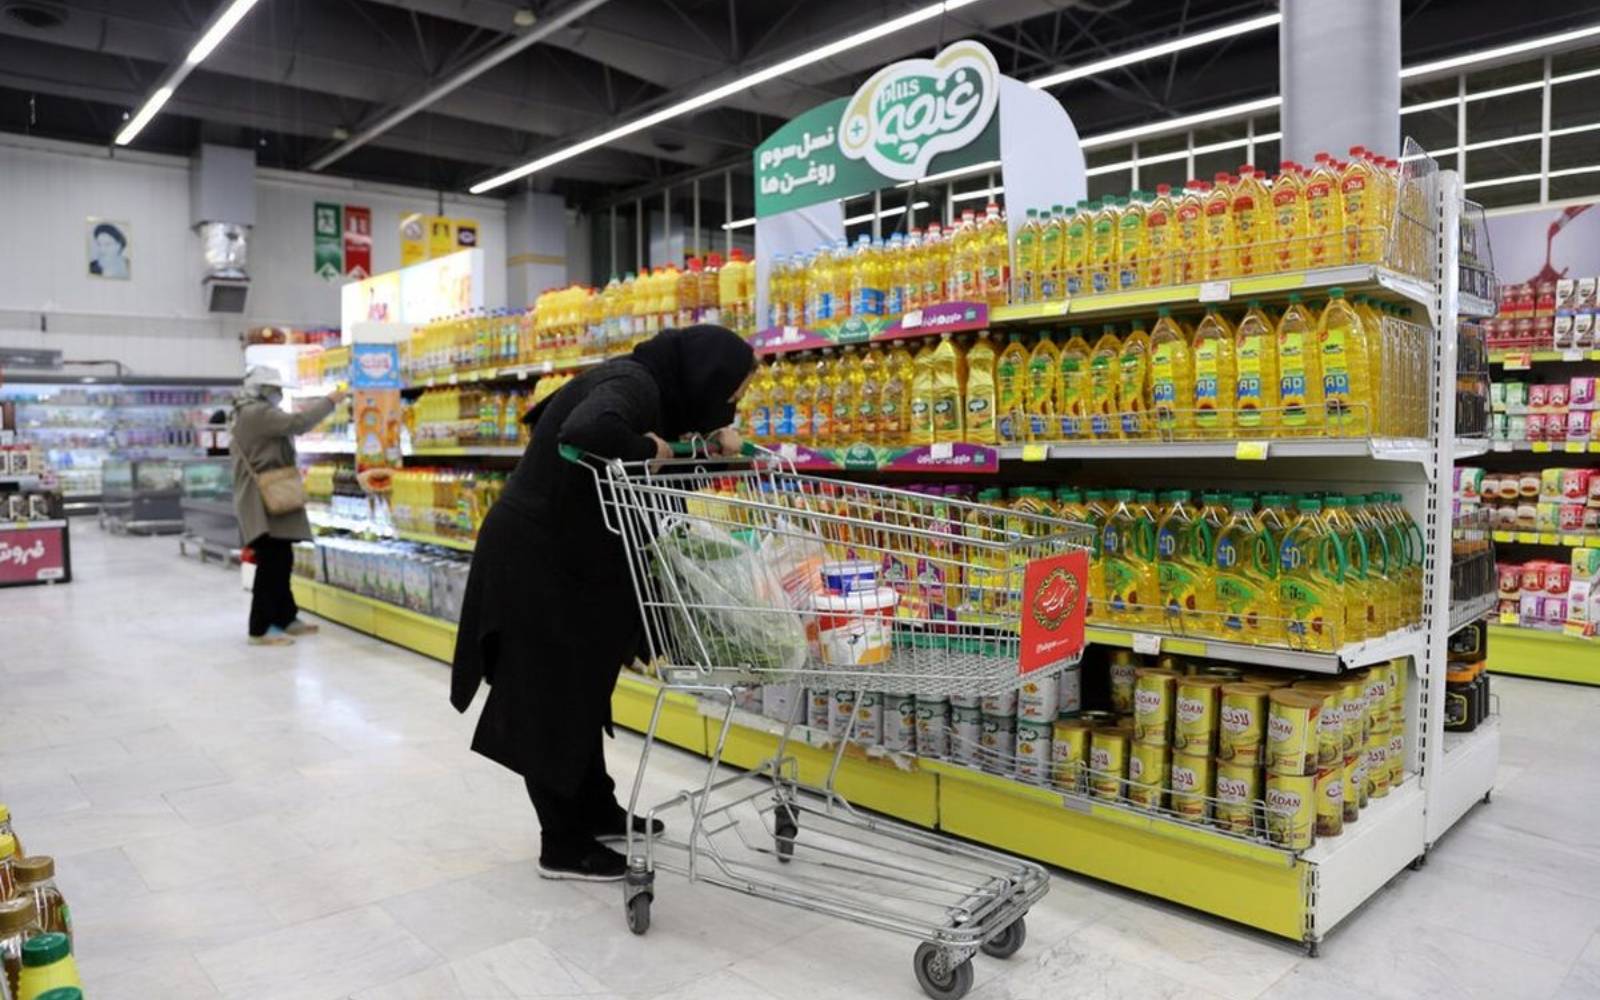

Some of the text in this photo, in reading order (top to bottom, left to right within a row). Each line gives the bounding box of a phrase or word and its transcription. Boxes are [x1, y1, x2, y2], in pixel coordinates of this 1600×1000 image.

[760, 126, 835, 171] نسل سوم
[760, 160, 836, 195] روغن ها
